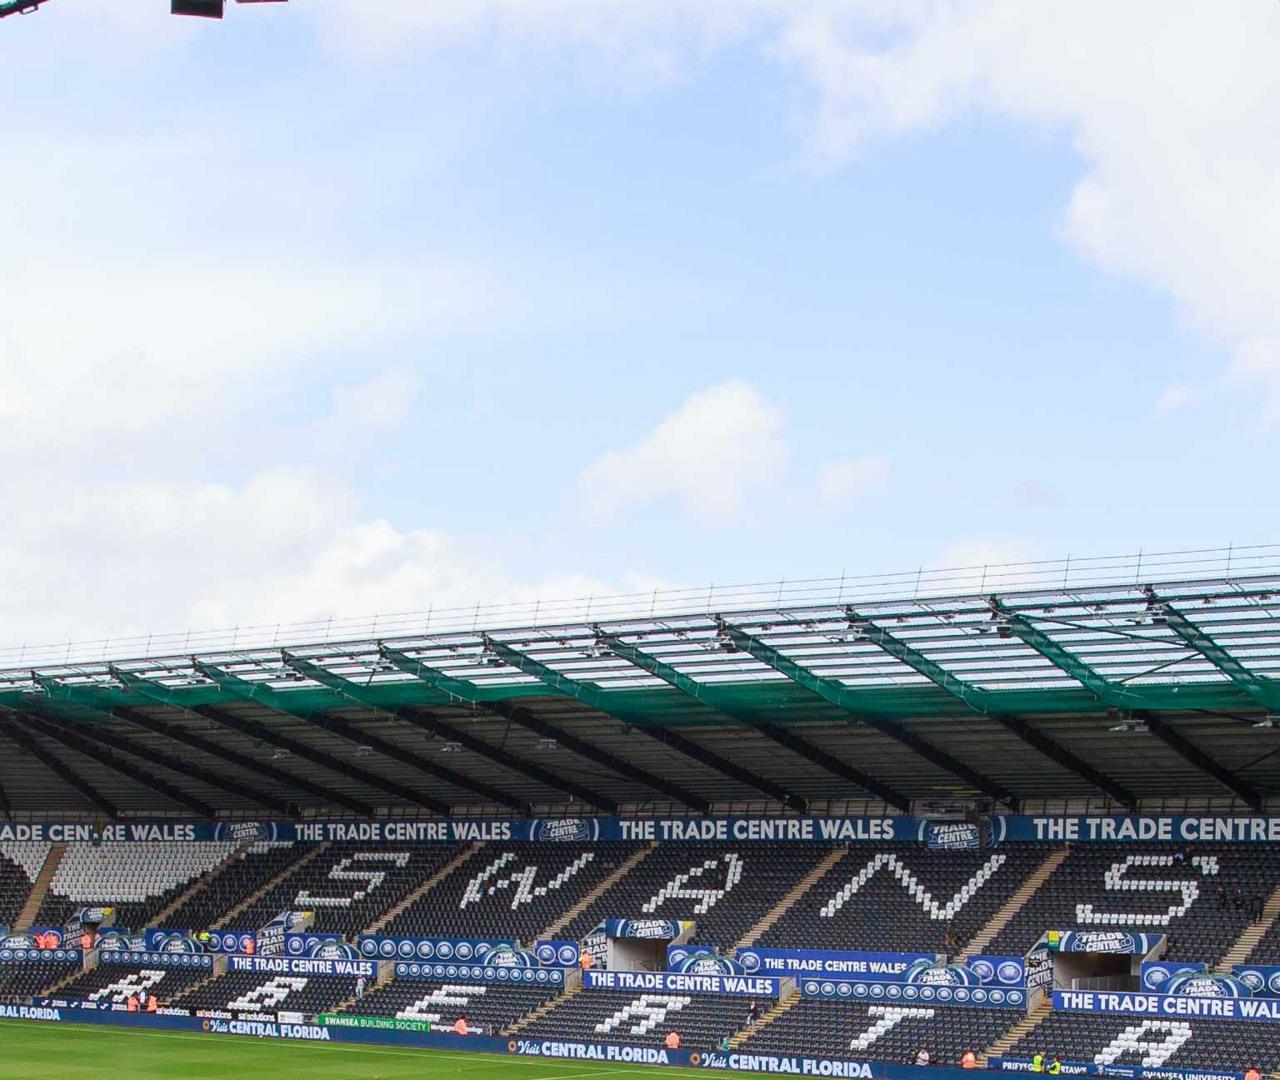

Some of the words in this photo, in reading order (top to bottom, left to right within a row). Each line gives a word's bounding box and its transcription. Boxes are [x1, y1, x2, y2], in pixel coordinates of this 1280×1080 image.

[131, 824, 195, 840] WALES
[295, 824, 322, 840] THE
[328, 824, 378, 840] TRADE
[384, 824, 447, 840] CENTRE
[452, 824, 511, 840] WALES
[620, 820, 655, 840] THE
[661, 820, 728, 840] TRADE
[733, 820, 813, 840] CENTRE
[819, 820, 894, 840] WALES
[1033, 818, 1079, 841] THE
[1086, 818, 1173, 841] TRADE
[233, 957, 252, 970] THE
[254, 958, 288, 972] TRADE
[292, 960, 332, 974] CENTRE
[334, 961, 372, 975] WALES
[764, 958, 785, 969] THE
[787, 959, 822, 971] TRADE
[825, 960, 867, 972] CENTRE
[869, 961, 907, 973] WALES
[590, 972, 615, 987] THE
[618, 973, 663, 989] TRADE
[667, 975, 720, 991] CENTRE
[723, 977, 773, 994] WALES
[19, 1006, 60, 1020] FLORIDA
[1061, 992, 1093, 1009] THE
[1098, 994, 1158, 1012] TRADE
[1163, 997, 1234, 1016] CENTRE
[229, 1020, 279, 1036] CENTRAL
[280, 1023, 330, 1040] FLORIDA
[324, 1016, 359, 1026] SWANSEA
[360, 1017, 394, 1029] BUILDING
[395, 1019, 427, 1031] SOCIETY
[517, 1040, 540, 1054] Visit
[541, 1042, 605, 1060] CENTRAL
[606, 1045, 669, 1064] FLORIDA
[701, 1053, 728, 1069] Visit
[729, 1054, 801, 1074] CENTRAL
[803, 1058, 873, 1078] FLORIDA
